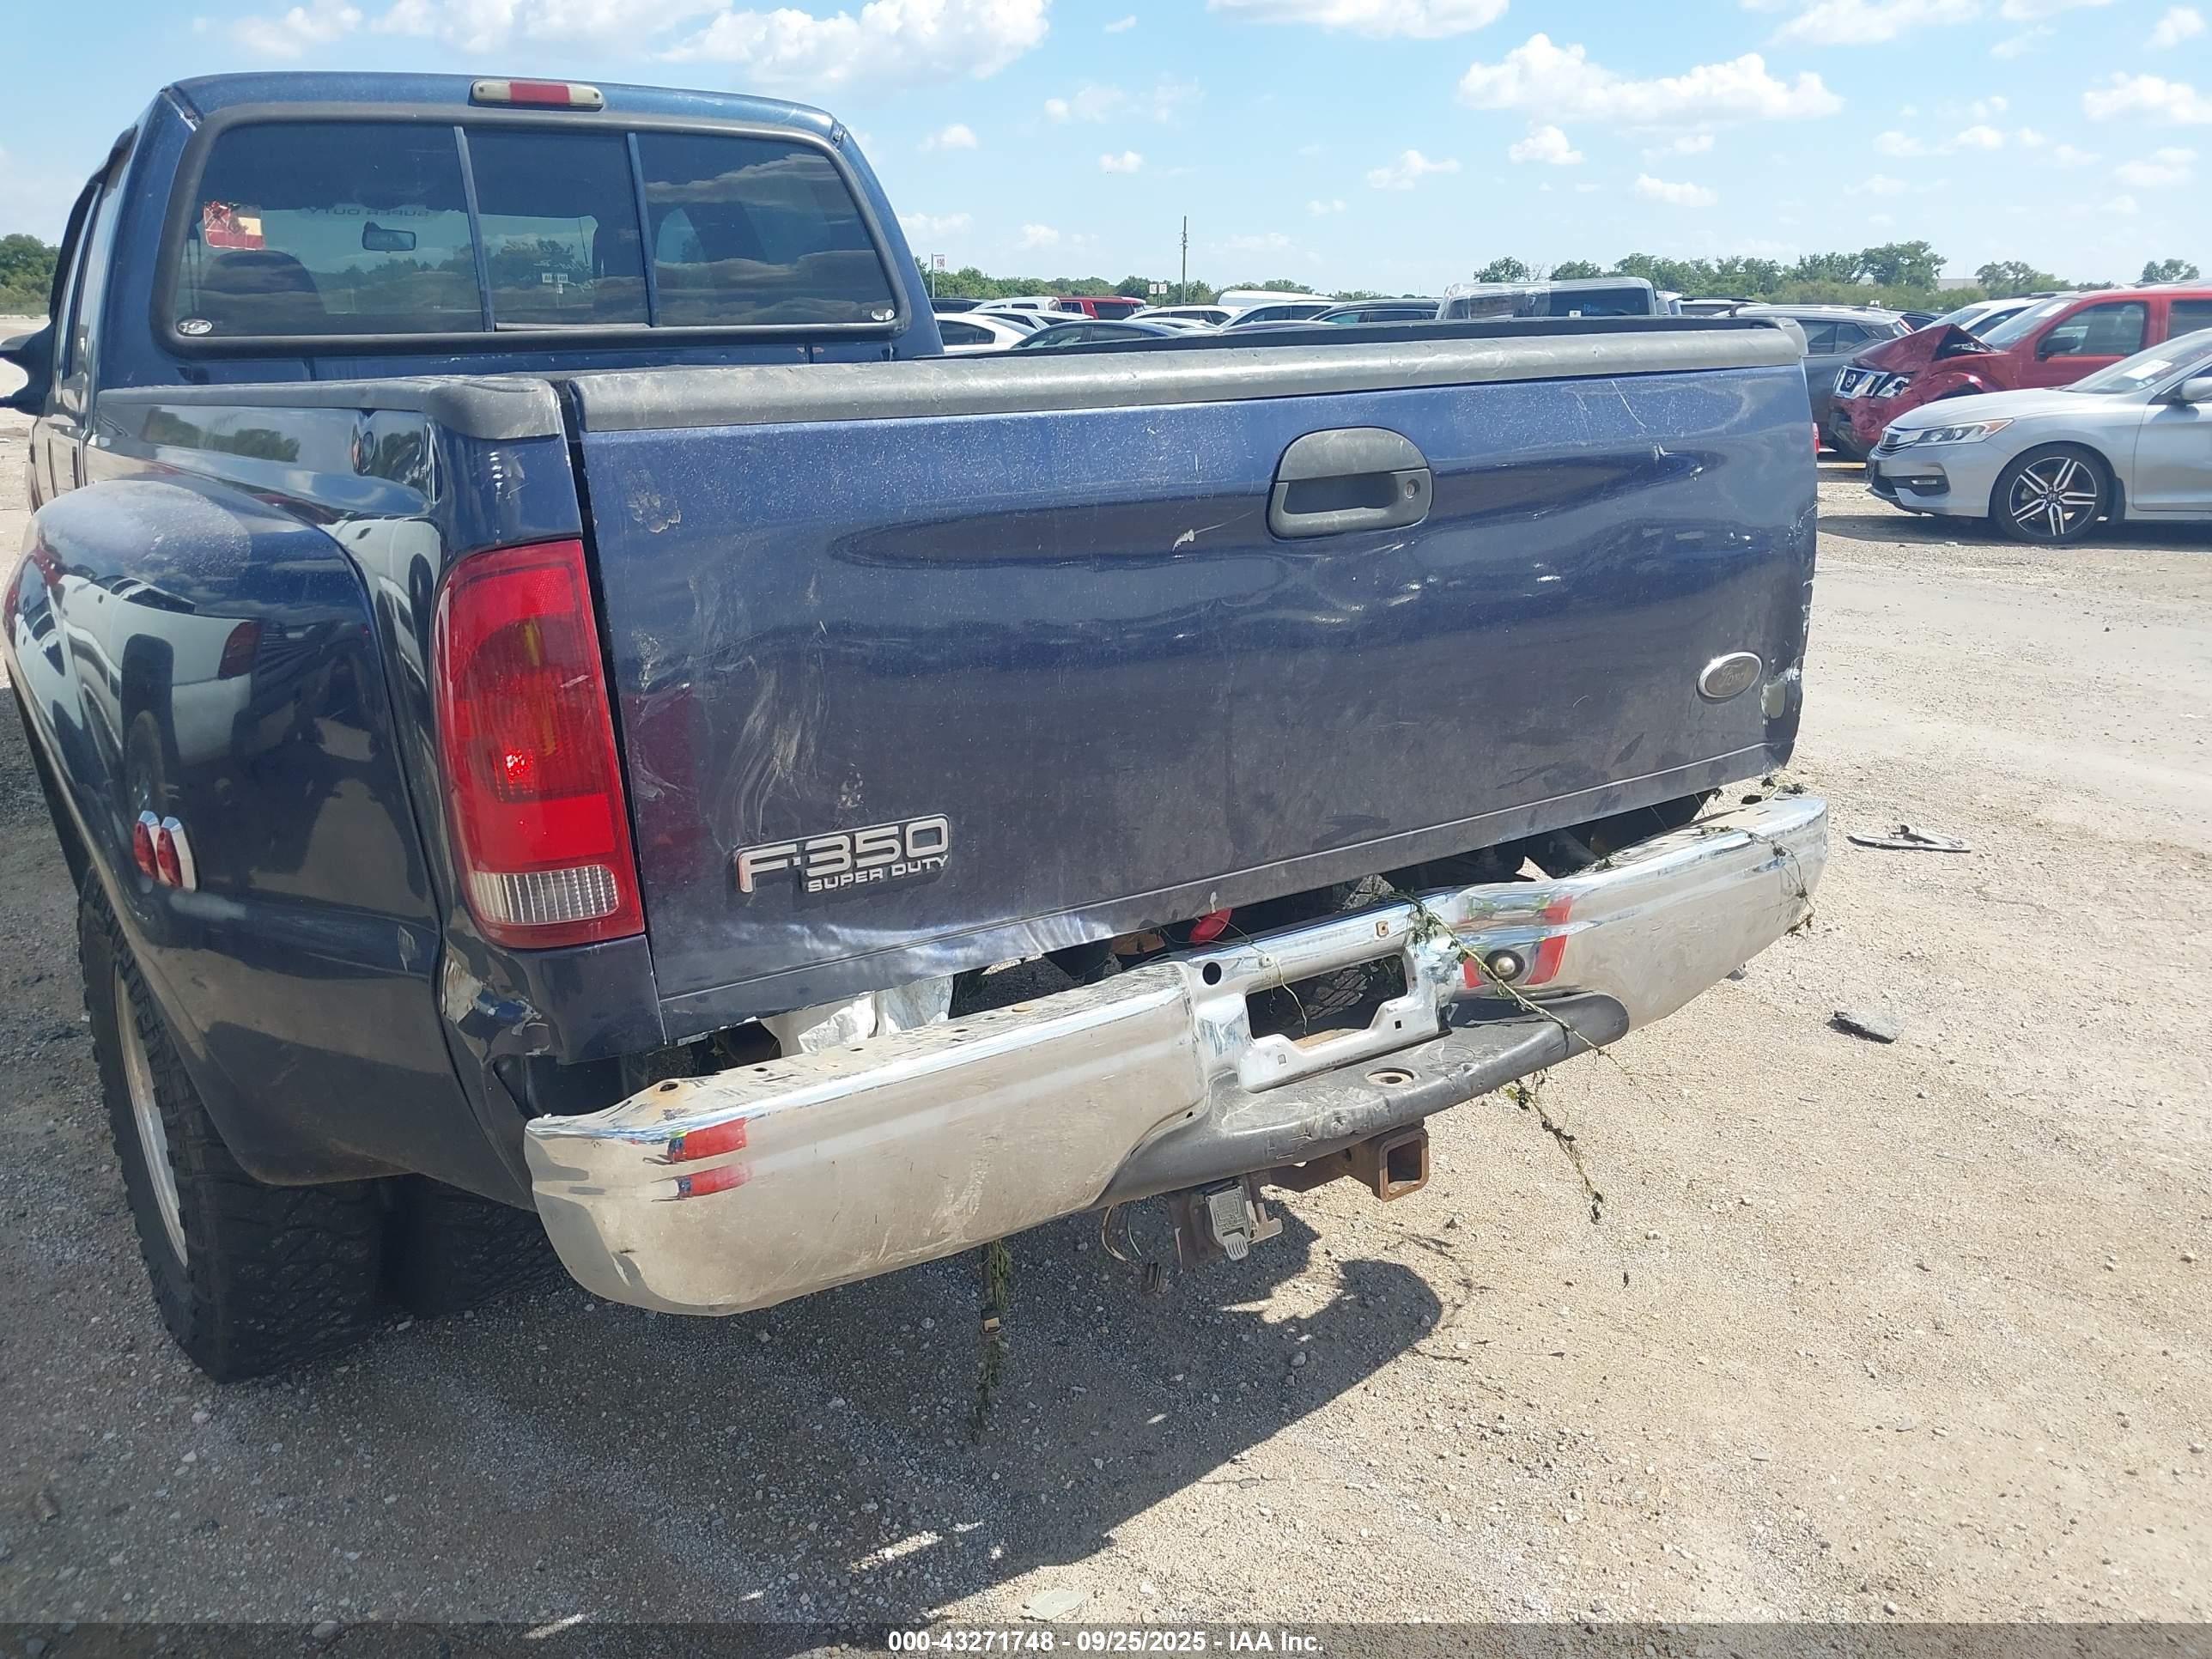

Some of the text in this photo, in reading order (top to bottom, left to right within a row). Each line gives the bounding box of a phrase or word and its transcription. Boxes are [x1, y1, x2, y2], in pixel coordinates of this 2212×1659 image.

[738, 817, 949, 893] F-350
[807, 854, 949, 893] SUPER DUTY
